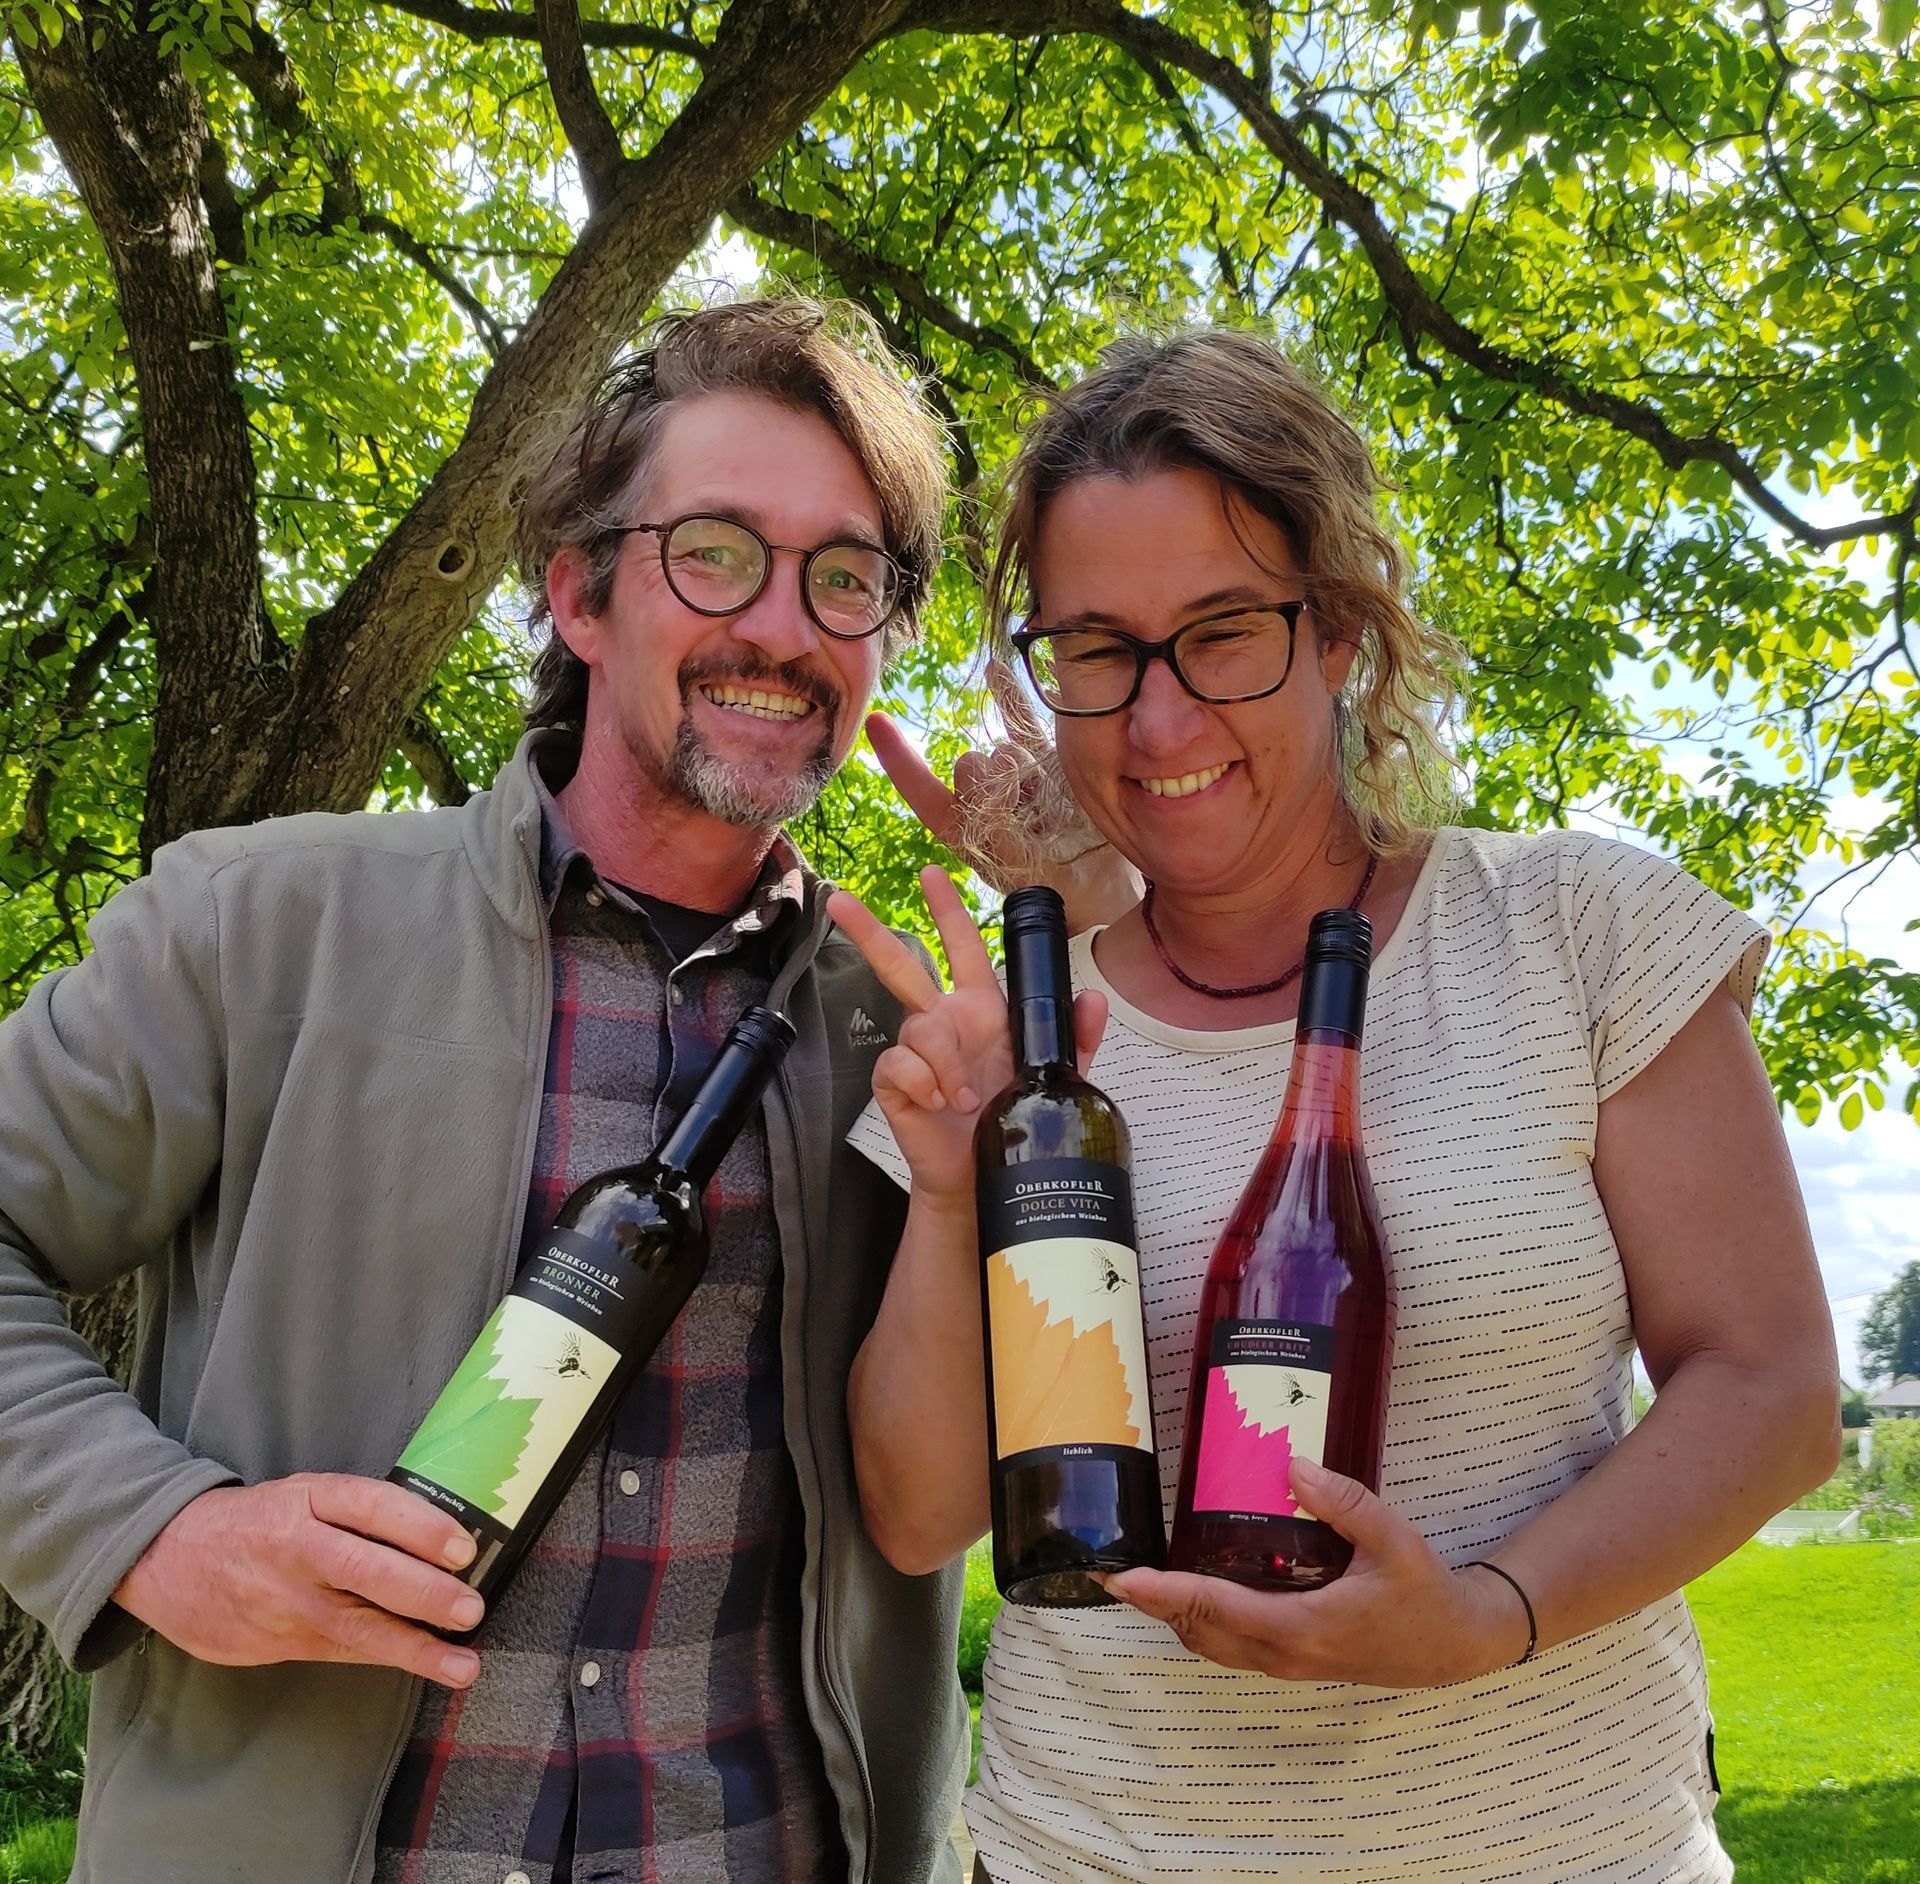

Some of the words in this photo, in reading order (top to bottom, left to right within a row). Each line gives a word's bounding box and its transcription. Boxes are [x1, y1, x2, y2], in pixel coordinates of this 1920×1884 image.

[1015, 1180, 1103, 1195] OBERKOFLER
[1021, 1199, 1066, 1213] DOLCE
[1070, 1198, 1101, 1210] VITA
[1028, 1211, 1076, 1223] biologischem
[1078, 1212, 1108, 1222] Weinbau
[548, 1246, 620, 1288] OBERKOFLER
[542, 1265, 601, 1300] BRONNER
[1239, 1326, 1301, 1337] OBERKOFLER
[1063, 1446, 1094, 1456] lieblich
